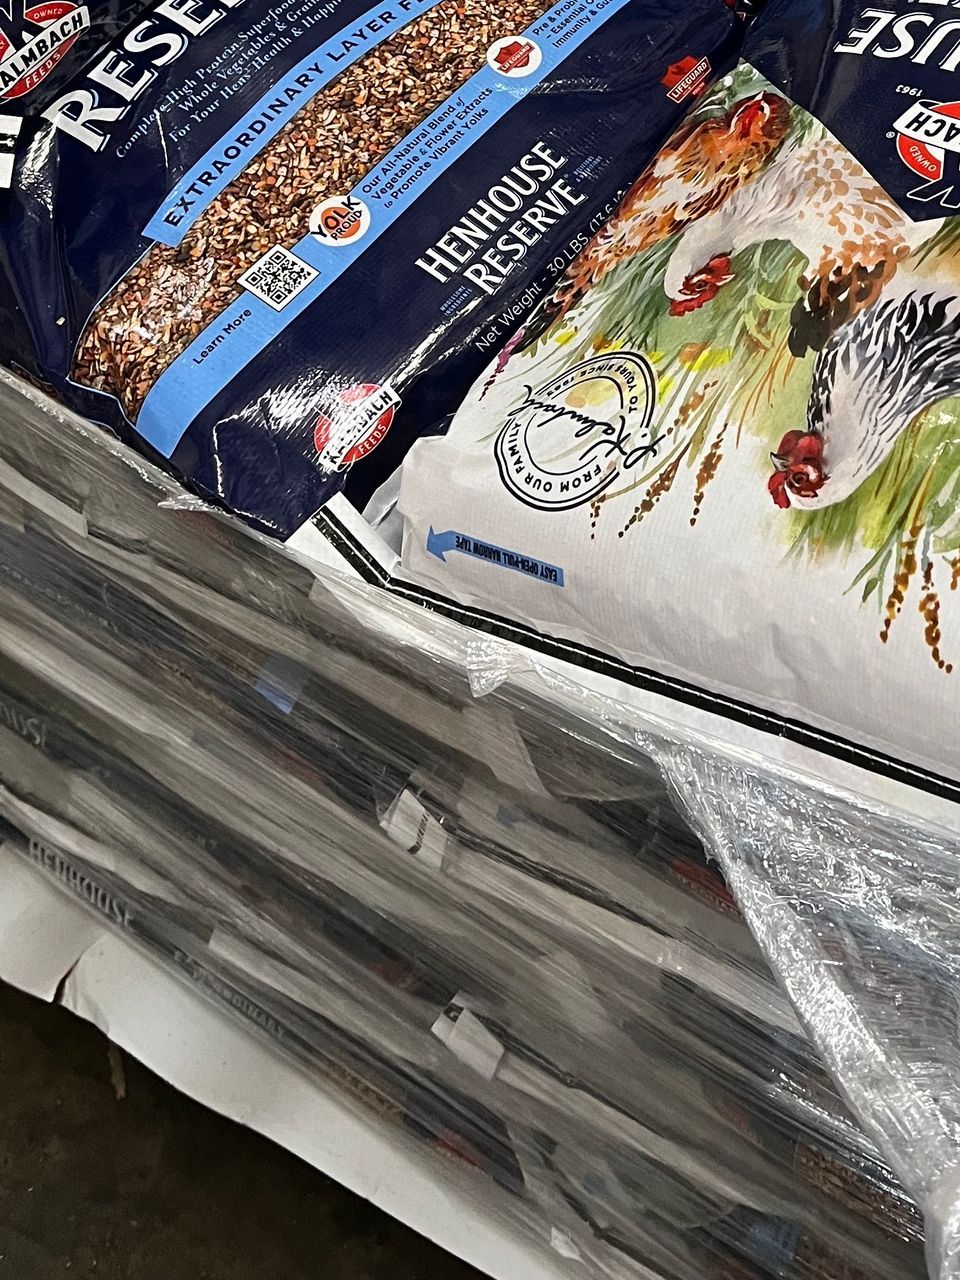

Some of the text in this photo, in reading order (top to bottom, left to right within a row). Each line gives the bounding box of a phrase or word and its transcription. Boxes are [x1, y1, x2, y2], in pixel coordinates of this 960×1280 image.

[24, 51, 62, 90] FEEDS
[167, 121, 190, 145] For
[189, 96, 224, 129] Your
[251, 37, 291, 75] Health
[178, 79, 218, 117] Whole
[215, 28, 276, 84] Vegetables
[671, 60, 709, 97] LIFEGUARD
[895, 83, 922, 97] 1963
[163, 60, 323, 230] EXTRAORDINARY
[328, 8, 398, 62] LAYER
[427, 104, 457, 131] Blend
[371, 86, 494, 201] Vegetable Flower Extracts
[390, 107, 489, 200] Promote Vibrant Yolks
[908, 144, 938, 172] OWNED
[310, 196, 362, 241] YOLK
[331, 211, 364, 242] PROUD
[414, 140, 567, 284] HENHOUSE
[462, 175, 588, 296] RESERVE
[474, 257, 566, 353] Net Weight 30
[191, 308, 253, 366] Learn More
[578, 363, 615, 378] SINCE
[615, 363, 639, 414] TO YOURS
[358, 422, 387, 455] FEEDS
[507, 421, 602, 493] FROM OUR FAMILY
[455, 535, 558, 582] EASY NARROW TAPE
